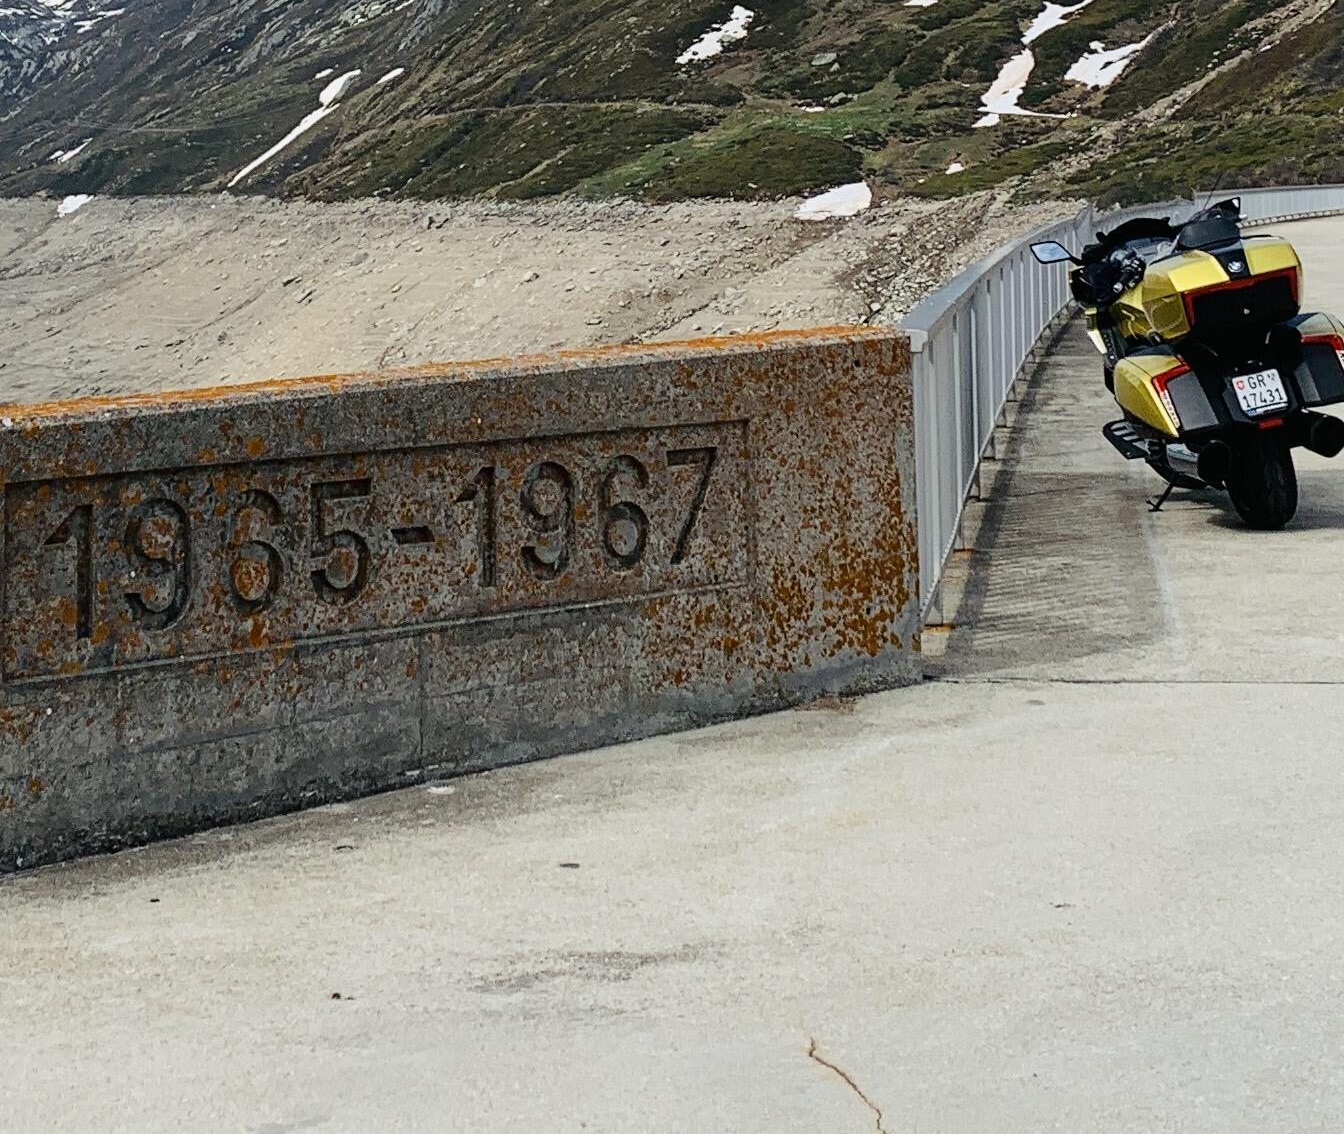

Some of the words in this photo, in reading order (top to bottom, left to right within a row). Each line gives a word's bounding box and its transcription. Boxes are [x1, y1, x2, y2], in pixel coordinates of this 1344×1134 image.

[1247, 374, 1267, 389] GR
[1242, 388, 1284, 408] 17431
[43, 446, 718, 639] 1965-1967
